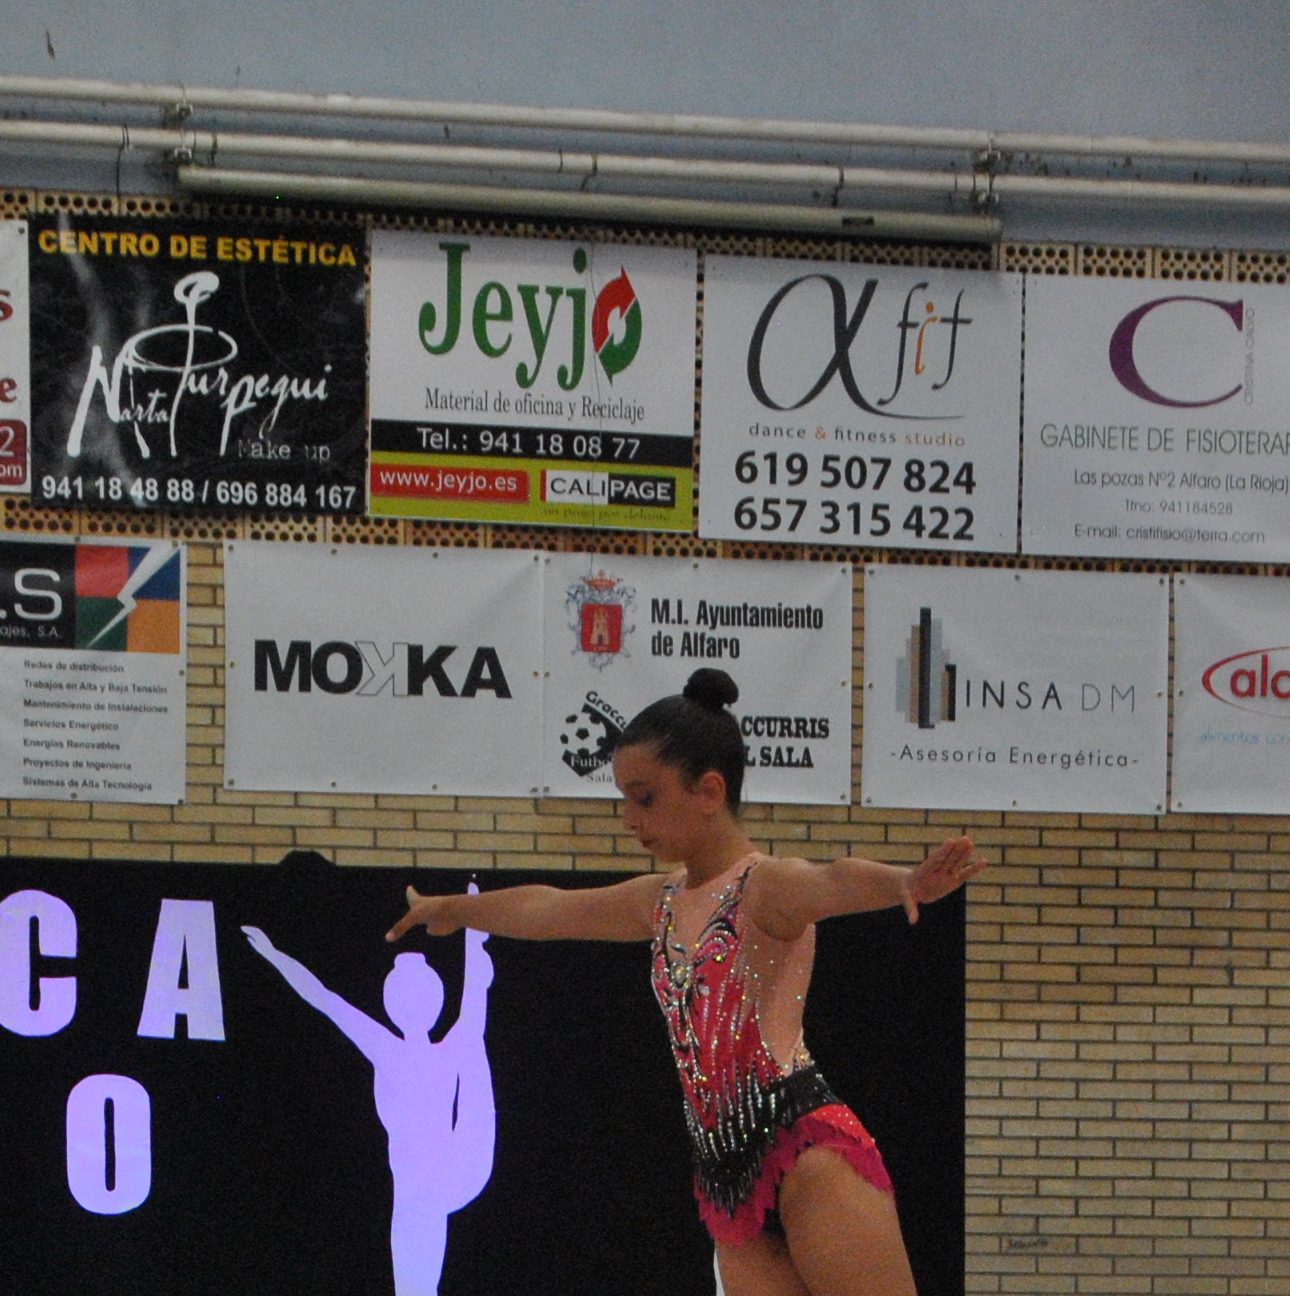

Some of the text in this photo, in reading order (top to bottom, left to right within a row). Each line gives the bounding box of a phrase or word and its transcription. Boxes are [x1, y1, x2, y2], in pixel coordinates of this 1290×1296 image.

[39, 230, 356, 267] CENTRO DE ESTÉTICA
[1109, 295, 1244, 408] C
[424, 386, 645, 425] Material de oficina y Reciclaje
[417, 427, 640, 460] Tel.: 941 18 08 77
[749, 422, 965, 447] dance & fitness studio
[1040, 423, 1139, 451] GABINETE
[1147, 427, 1174, 451] DE
[239, 438, 331, 463] Make up
[380, 468, 518, 493] www.jeyjo.es
[735, 450, 976, 495] 619 507 824
[1074, 469, 1097, 486] Las
[1101, 471, 1144, 488] pozas
[1179, 471, 1221, 489] Alfaro
[1225, 473, 1245, 494] (La
[1250, 473, 1289, 494] Rioja)
[42, 475, 356, 508] 941 18 48 88 696 884 167
[550, 477, 672, 500] CALIPAGE
[734, 496, 975, 541] 657 315 422
[1159, 499, 1233, 516] 941184528
[1074, 523, 1121, 540] E-mail:
[650, 599, 824, 630] M.I. Ayuntamiento
[651, 630, 741, 659] de Alfaro
[254, 639, 512, 698] MOKKA
[965, 679, 1135, 713] INSA DM
[741, 715, 830, 738] CCURRIS
[759, 745, 814, 768] SALA
